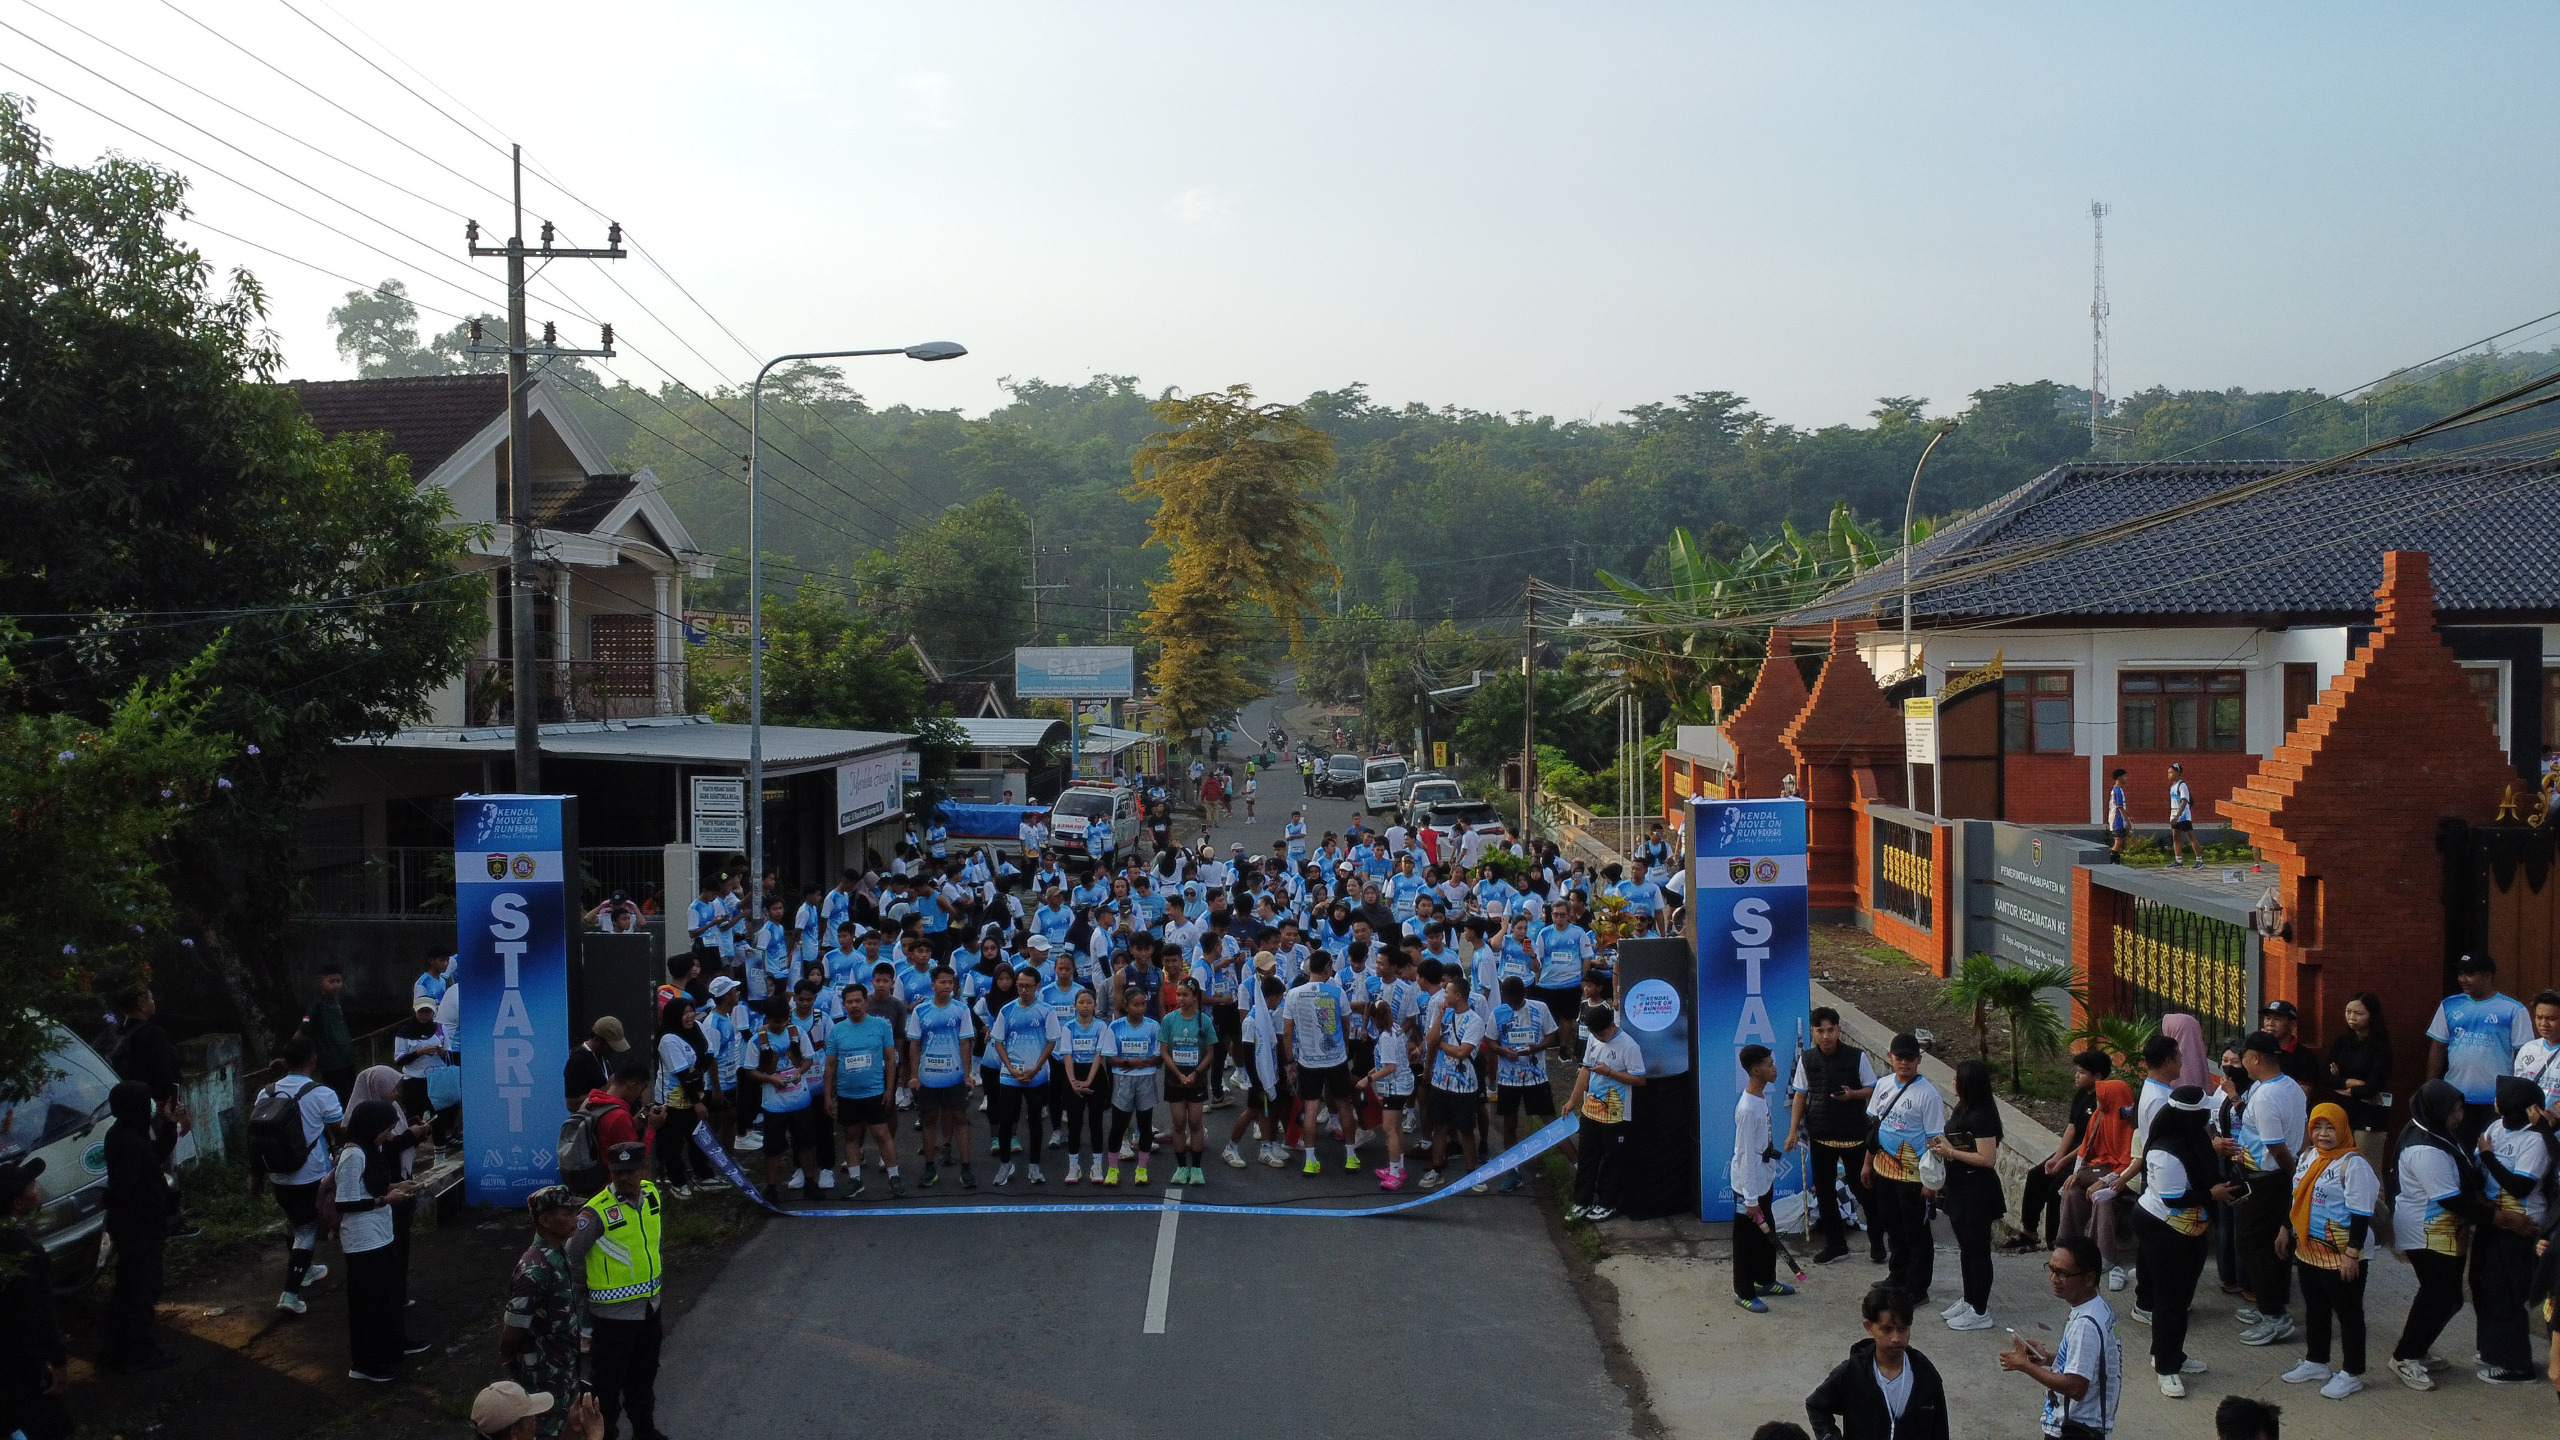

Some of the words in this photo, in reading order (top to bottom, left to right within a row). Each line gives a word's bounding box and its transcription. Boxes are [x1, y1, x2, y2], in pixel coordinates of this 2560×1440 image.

[1047, 658, 1100, 676] SAE
[498, 808, 535, 817] KENDAL
[1741, 811, 1778, 820] KENDAL
[496, 816, 523, 825] MOVE
[524, 816, 539, 825] ON
[1739, 820, 1766, 829] MOVE
[1768, 819, 1782, 828] ON
[2000, 865, 2029, 883] PEMERINTAH
[2029, 874, 2059, 893] KABUPATEN
[1995, 898, 2019, 918] KANTOR
[2019, 906, 2057, 932] KECAMATAN
[489, 892, 536, 1133] START
[2464, 1031, 2493, 1041] KENDAL
[1039, 1204, 1120, 1212] KENDAL
[1189, 1204, 1221, 1213] ON
